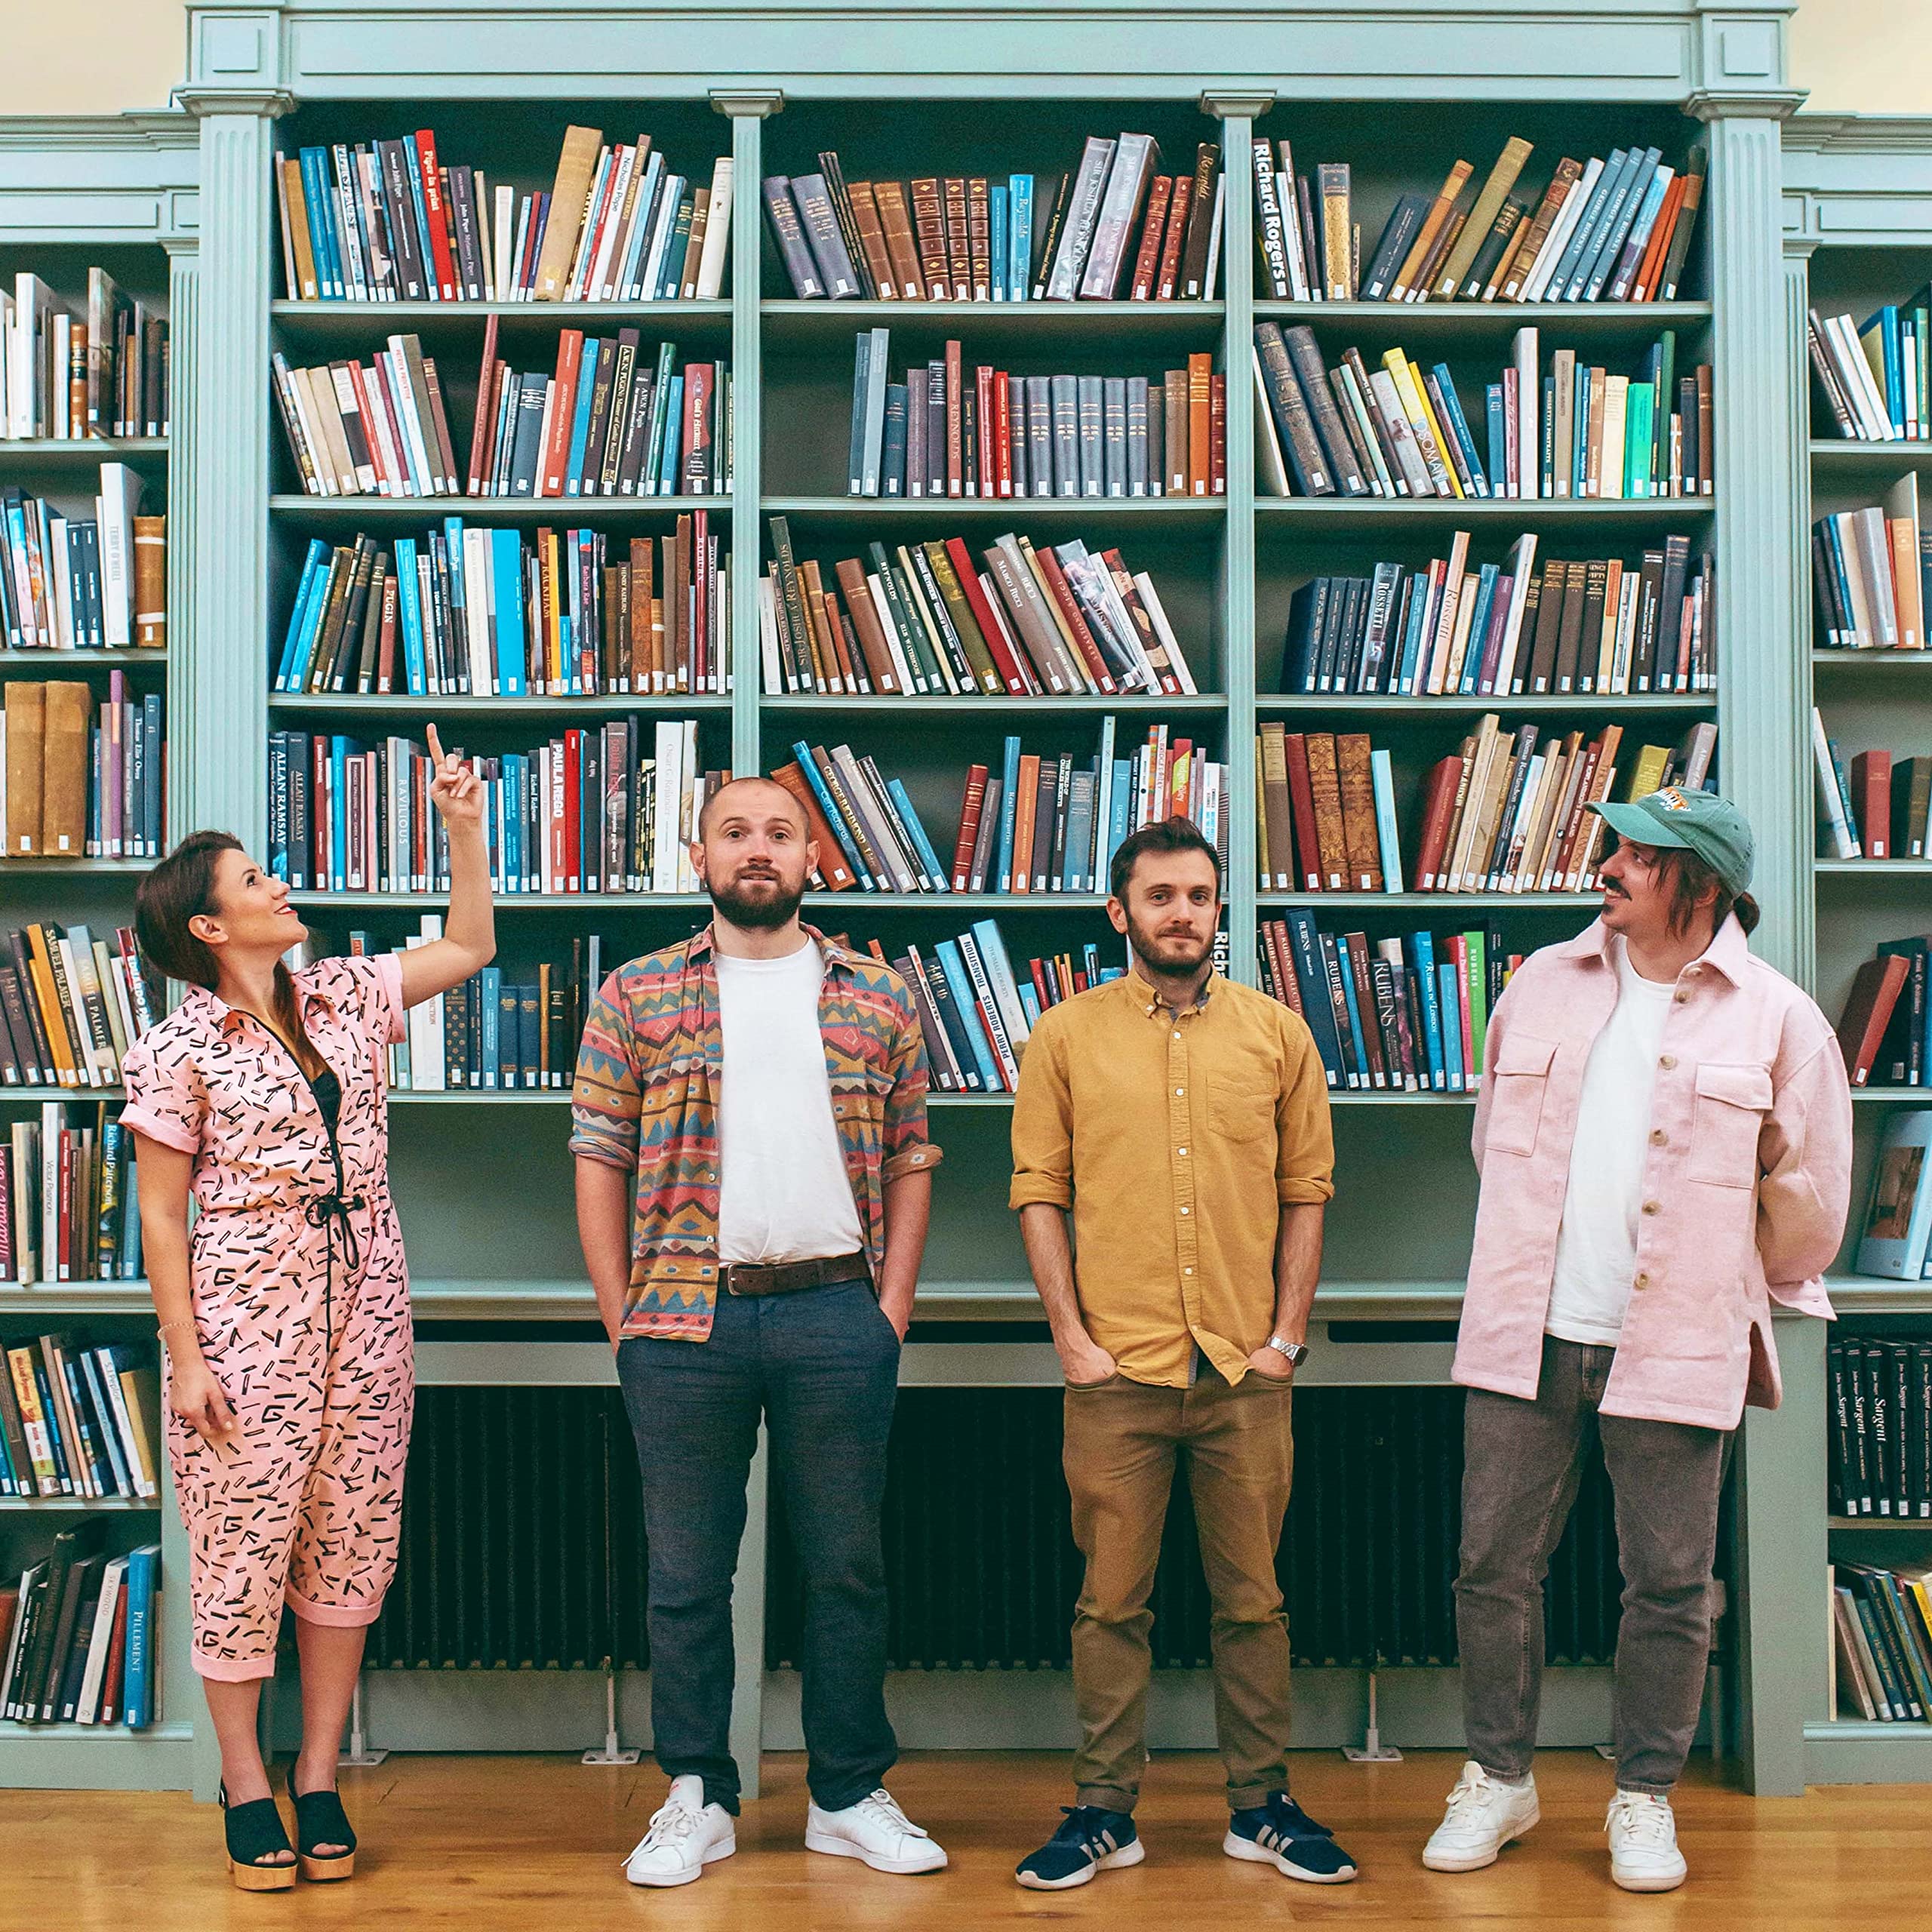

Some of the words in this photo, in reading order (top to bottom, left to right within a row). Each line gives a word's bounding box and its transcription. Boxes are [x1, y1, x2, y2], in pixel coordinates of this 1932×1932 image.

[424, 151, 435, 174] Piper
[617, 157, 631, 190] Nicholas
[1092, 161, 1102, 174] SIR
[1127, 156, 1136, 171] SIR
[1198, 155, 1214, 199] Reynolds
[1254, 143, 1278, 214] Richard
[428, 177, 436, 186] in
[1082, 177, 1097, 214] JOSHUA
[1117, 174, 1132, 211] JOSHUA
[426, 189, 439, 211] print
[460, 205, 468, 217] John
[612, 192, 623, 211] Pope
[1589, 189, 1607, 220] GEORGE
[1608, 187, 1627, 220] GEORGE
[1625, 187, 1644, 219] GEORGE
[1017, 198, 1028, 238] Reynolds
[1105, 216, 1123, 264] REYNOLDS
[1265, 217, 1286, 279] Rogers
[1572, 223, 1592, 255] ROMNEY
[1591, 222, 1612, 255] ROMNEY
[1609, 221, 1631, 254] ROMNEY
[395, 349, 405, 371] PATRICK
[694, 398, 702, 418] God's
[949, 403, 959, 459] REYNOLDS
[109, 525, 118, 550] TERRY
[110, 552, 121, 581] O'NEILL
[780, 543, 796, 601] REYNOLDS
[880, 561, 897, 601] REYNOLDS
[996, 560, 1013, 587] MARCO
[1009, 588, 1023, 608] RICCI
[1020, 576, 1036, 598] RICCI
[384, 589, 395, 623] PUGIN
[1373, 582, 1389, 629] ROSSETTI
[1438, 589, 1458, 640] Rossetti
[780, 621, 790, 652] REYNOLDS
[798, 645, 807, 666] SIR
[553, 744, 563, 784] PAULA
[611, 739, 621, 771] paula
[665, 744, 673, 767] Oscar
[1521, 735, 1534, 761] Thomas
[277, 751, 286, 791] ALLAN
[295, 771, 303, 801] ALLAN
[1179, 758, 1187, 783] Bridget
[1512, 761, 1526, 802] Rowlandson
[553, 786, 563, 818] REGO
[823, 765, 846, 801] GEORGE
[839, 799, 866, 844] RICHMOND
[1177, 785, 1186, 801] Riley
[278, 795, 286, 844] RAMSAY
[295, 804, 303, 841] RAMSAY
[398, 779, 408, 844] RAVILIOUS
[827, 808, 848, 841] Richards
[1005, 809, 1014, 844] Allegories
[1569, 810, 1581, 837] ENGLAND
[1572, 813, 1594, 873] OWLANDSON
[1298, 921, 1310, 951] RUBENS
[45, 929, 62, 970] SAMUEL
[56, 969, 71, 1008] PALMER
[964, 941, 985, 989] TRANSITION
[1213, 931, 1229, 980] Richa
[1266, 937, 1281, 971] RUBENS
[1281, 937, 1294, 971] RUBENS
[1265, 974, 1274, 997] RUBEN
[1327, 960, 1344, 1005] RUBENS
[1425, 961, 1435, 992] RUBENS
[1374, 963, 1396, 1026] RUBENS
[88, 1006, 106, 1049] PALMER
[983, 995, 1001, 1032] ROBERTS
[1429, 1001, 1438, 1032] LONDON
[995, 1034, 1009, 1060] PERRY
[106, 1124, 116, 1160] Richard
[45, 1183, 54, 1216] Pasmore
[105, 1161, 116, 1205] Patterson
[1837, 1396, 1847, 1427] Sargent
[1899, 1386, 1907, 1409] Sargent
[1922, 1386, 1932, 1409] Sargent
[1854, 1396, 1866, 1434] Sargent
[1872, 1398, 1886, 1441] Sargent
[101, 1575, 115, 1616] SKYWOOD
[131, 1611, 143, 1673] PILLEMENT
